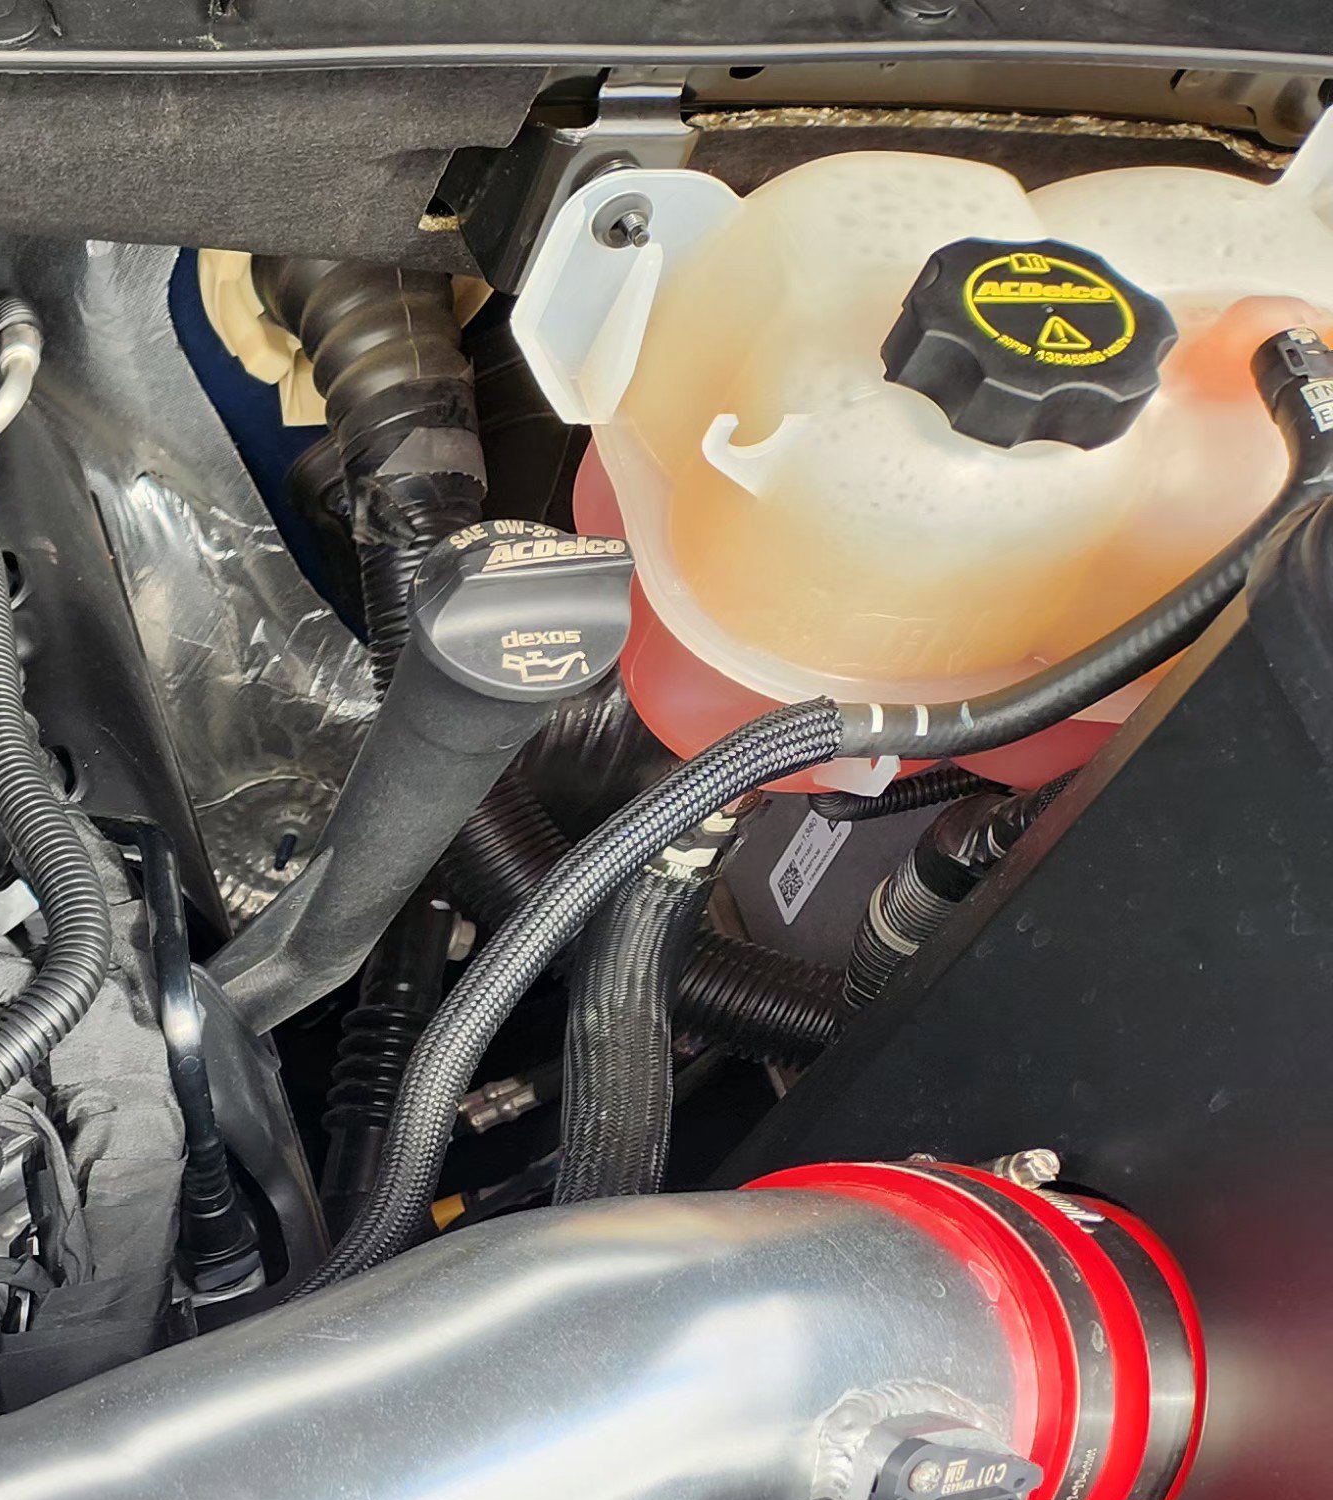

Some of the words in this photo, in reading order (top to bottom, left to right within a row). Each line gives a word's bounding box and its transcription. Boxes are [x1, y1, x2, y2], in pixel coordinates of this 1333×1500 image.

[976, 281, 1113, 300] ACDelco
[449, 524, 489, 550] SAE
[486, 537, 626, 565] ACDelco
[501, 630, 582, 649] dexos
